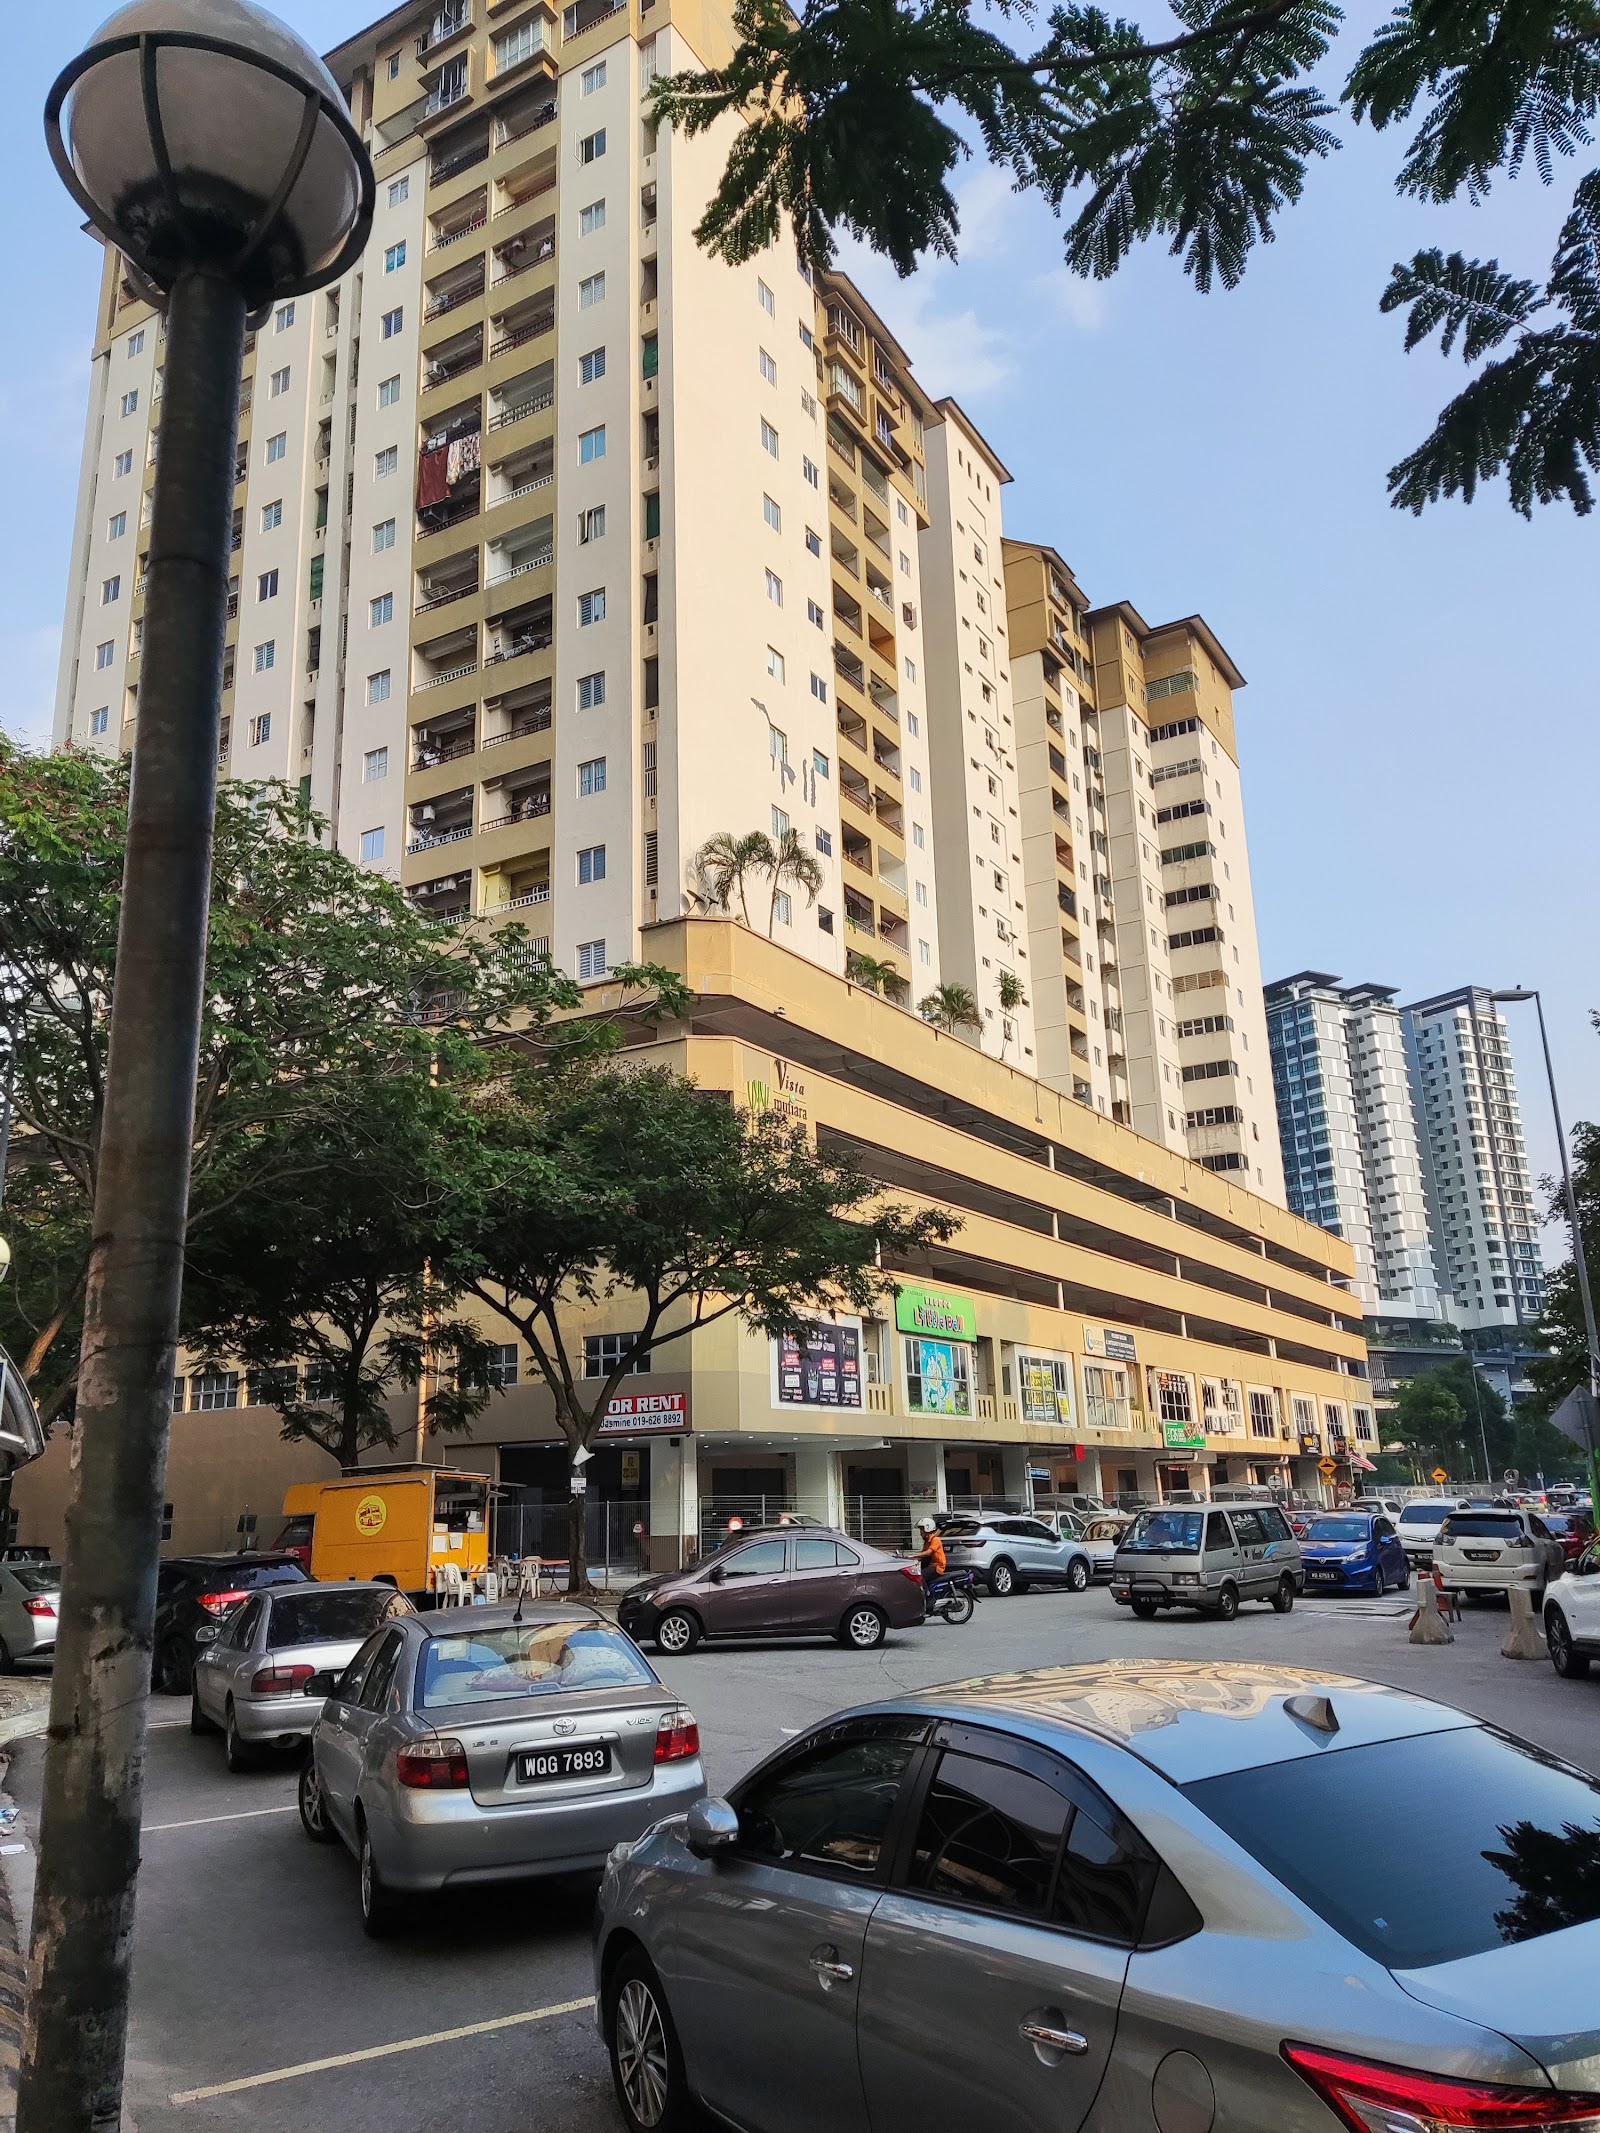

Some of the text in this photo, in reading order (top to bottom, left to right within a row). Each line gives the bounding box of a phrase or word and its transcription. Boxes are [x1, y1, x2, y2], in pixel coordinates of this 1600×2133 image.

[774, 1060, 805, 1095] Vista
[608, 1394, 682, 1415] OR RENT
[600, 1413, 681, 1428] Jasmine 019-626 8892
[525, 1750, 605, 1777] WQG 7893
